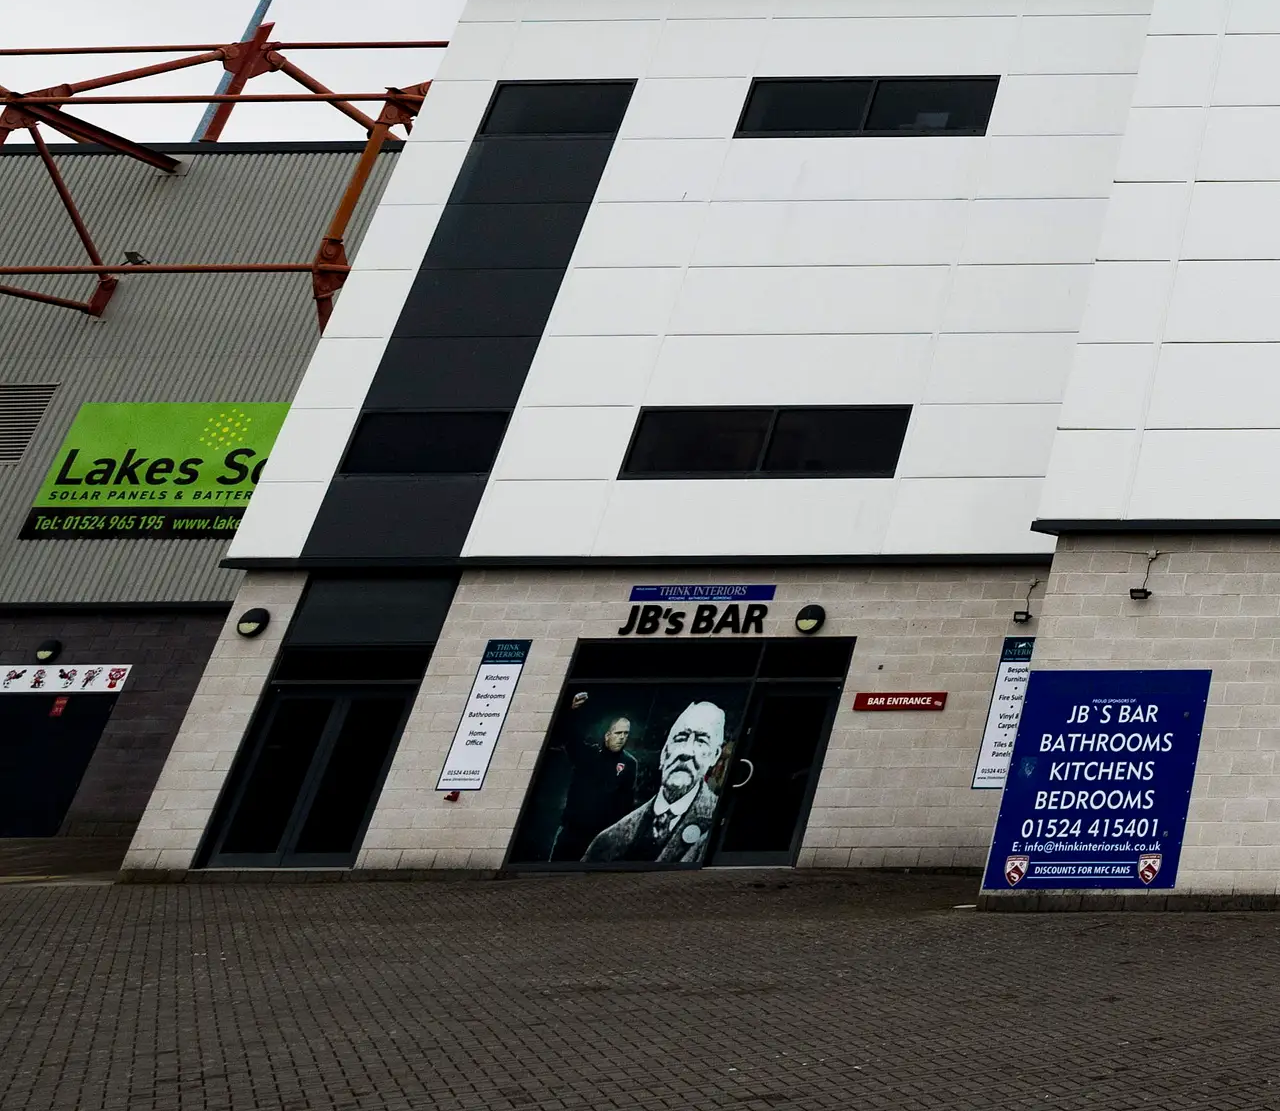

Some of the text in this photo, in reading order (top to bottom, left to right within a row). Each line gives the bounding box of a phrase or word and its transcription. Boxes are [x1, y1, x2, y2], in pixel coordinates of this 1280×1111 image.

[54, 448, 204, 486] Lakes
[48, 490, 101, 500] SOLAR
[107, 490, 168, 500] PANELS
[174, 490, 184, 500] &
[34, 515, 62, 531] Tel:
[63, 515, 104, 530] 01524
[109, 515, 135, 530] 965
[138, 515, 166, 530] 195
[660, 586, 747, 596] THINK INTERIORS
[617, 603, 768, 636] JB's BAR
[476, 692, 506, 700] Bedrooms
[867, 696, 932, 706] BAR ENTRANCE
[1118, 704, 1158, 723] BAR
[1039, 733, 1174, 752] BATHROOMS
[1049, 761, 1155, 781] KITCHENS
[1034, 790, 1155, 810] BEDROOMS
[1021, 818, 1159, 838] 01524 415401
[1012, 841, 1161, 853] E: info@thinkinteriorsuk.co.uk
[1034, 866, 1131, 875] DISCOUNTS FOR MFC FANS
